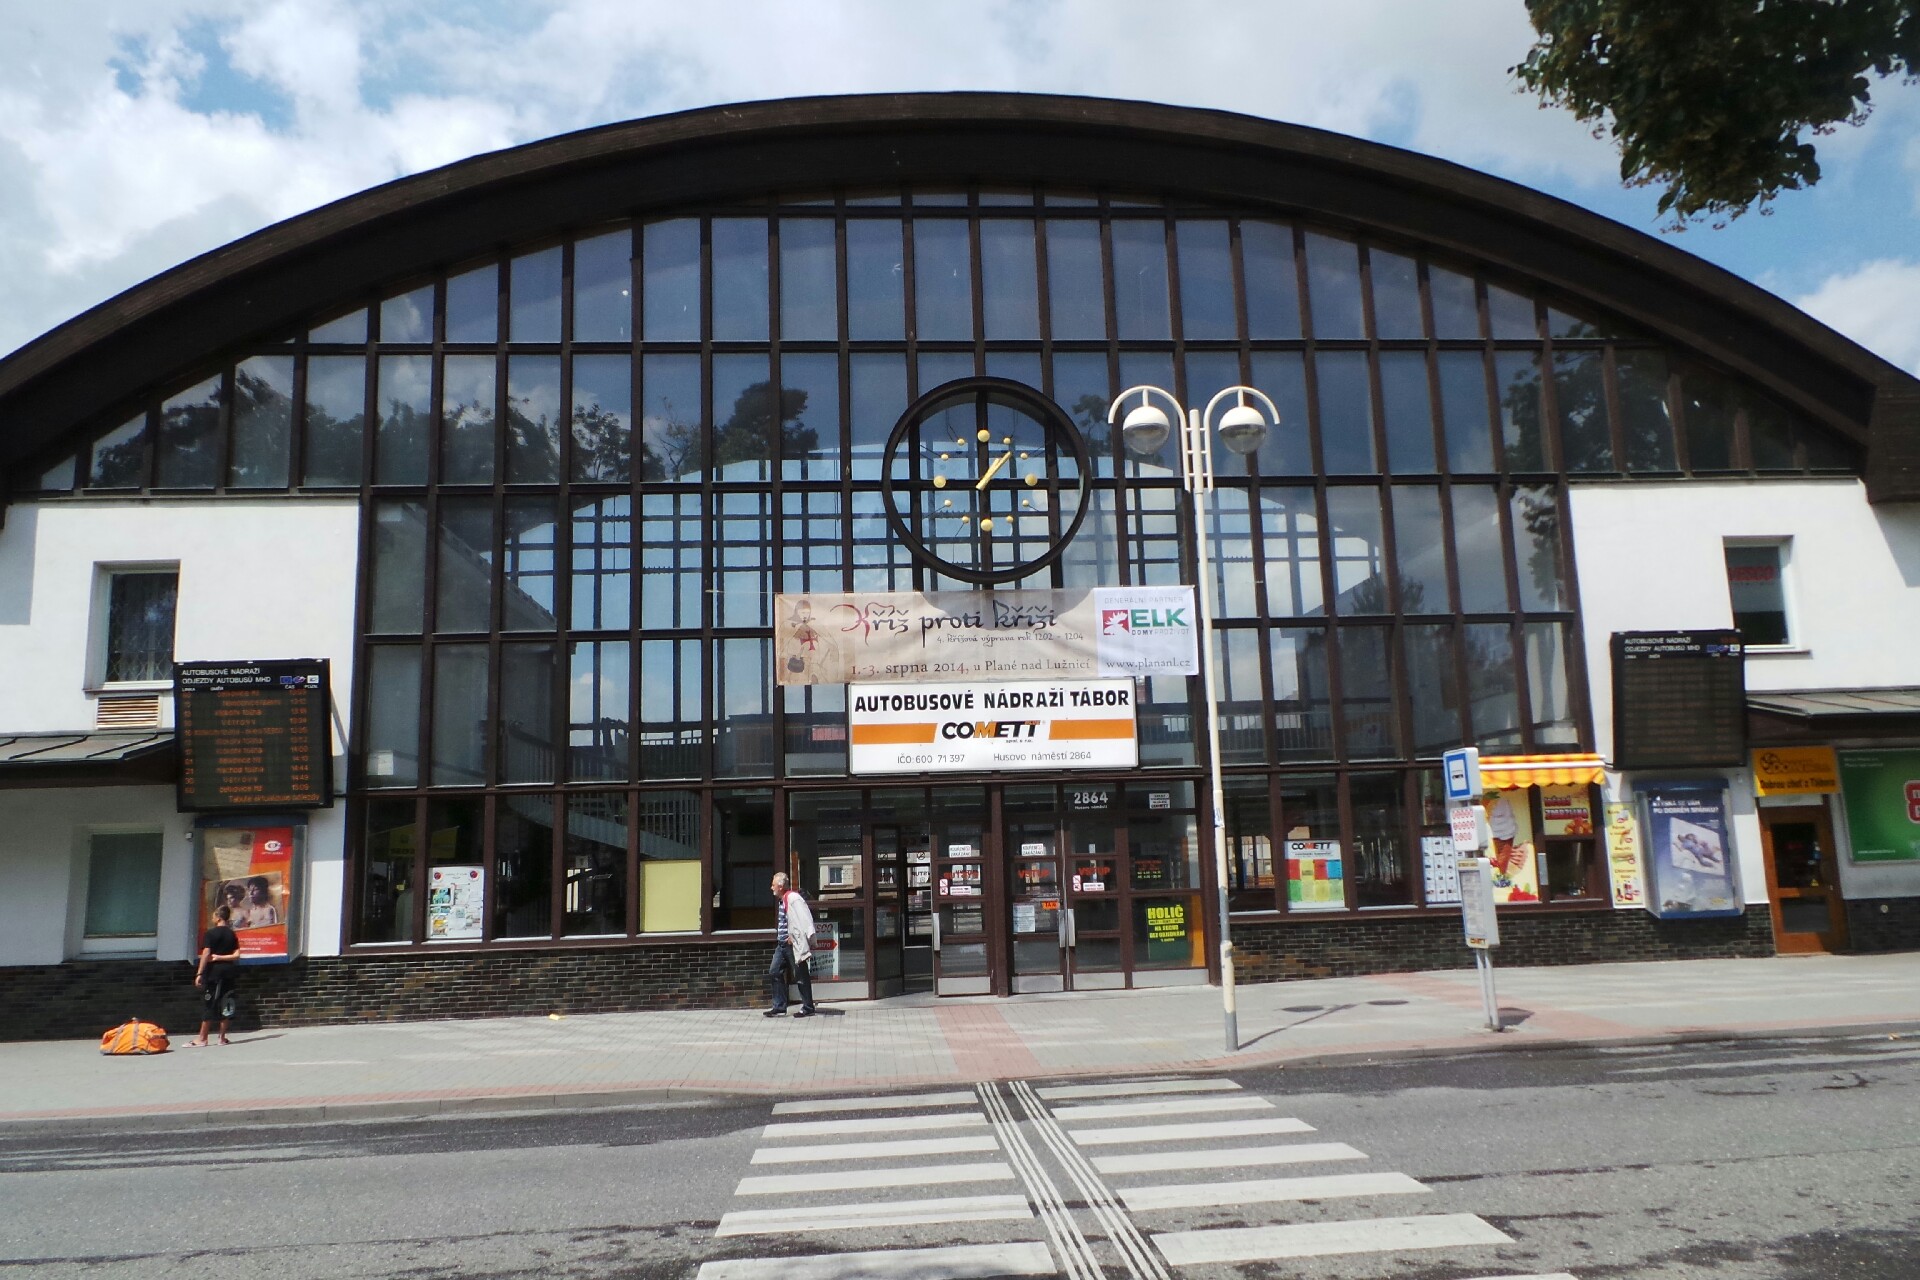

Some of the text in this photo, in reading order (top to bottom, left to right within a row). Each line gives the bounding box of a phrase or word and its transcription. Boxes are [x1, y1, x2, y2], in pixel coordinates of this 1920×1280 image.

[918, 611, 985, 648] proti
[992, 600, 1057, 633] kříži
[1131, 608, 1188, 628] ELK
[937, 635, 945, 644] 4.
[981, 634, 1014, 647] výprava
[1018, 631, 1033, 641] rok
[1034, 632, 1053, 641] 1202
[1065, 632, 1084, 641] 1204
[181, 667, 260, 676] AUTOBUSOVÉ NÁDRAŽÍ
[885, 663, 929, 677] srpna
[934, 663, 969, 674] 2014,
[985, 660, 1017, 671] Plané
[1021, 659, 1042, 671] nad
[1046, 658, 1091, 669] Lužnicí
[181, 677, 214, 685] ODJEZDY
[216, 676, 253, 684] AUTOBUSŮ
[855, 687, 1130, 712] AUTOBUSOVÉ NÁDRAŽÍ TÁBOR
[942, 720, 1040, 740] COMETT
[938, 754, 947, 763] 71
[949, 753, 965, 763] 397
[993, 750, 1092, 761] Husovo náměstí 2864
[1074, 792, 1108, 804] 2864
[1291, 842, 1333, 850] COMETT
[1147, 904, 1184, 919] HOLIČ
